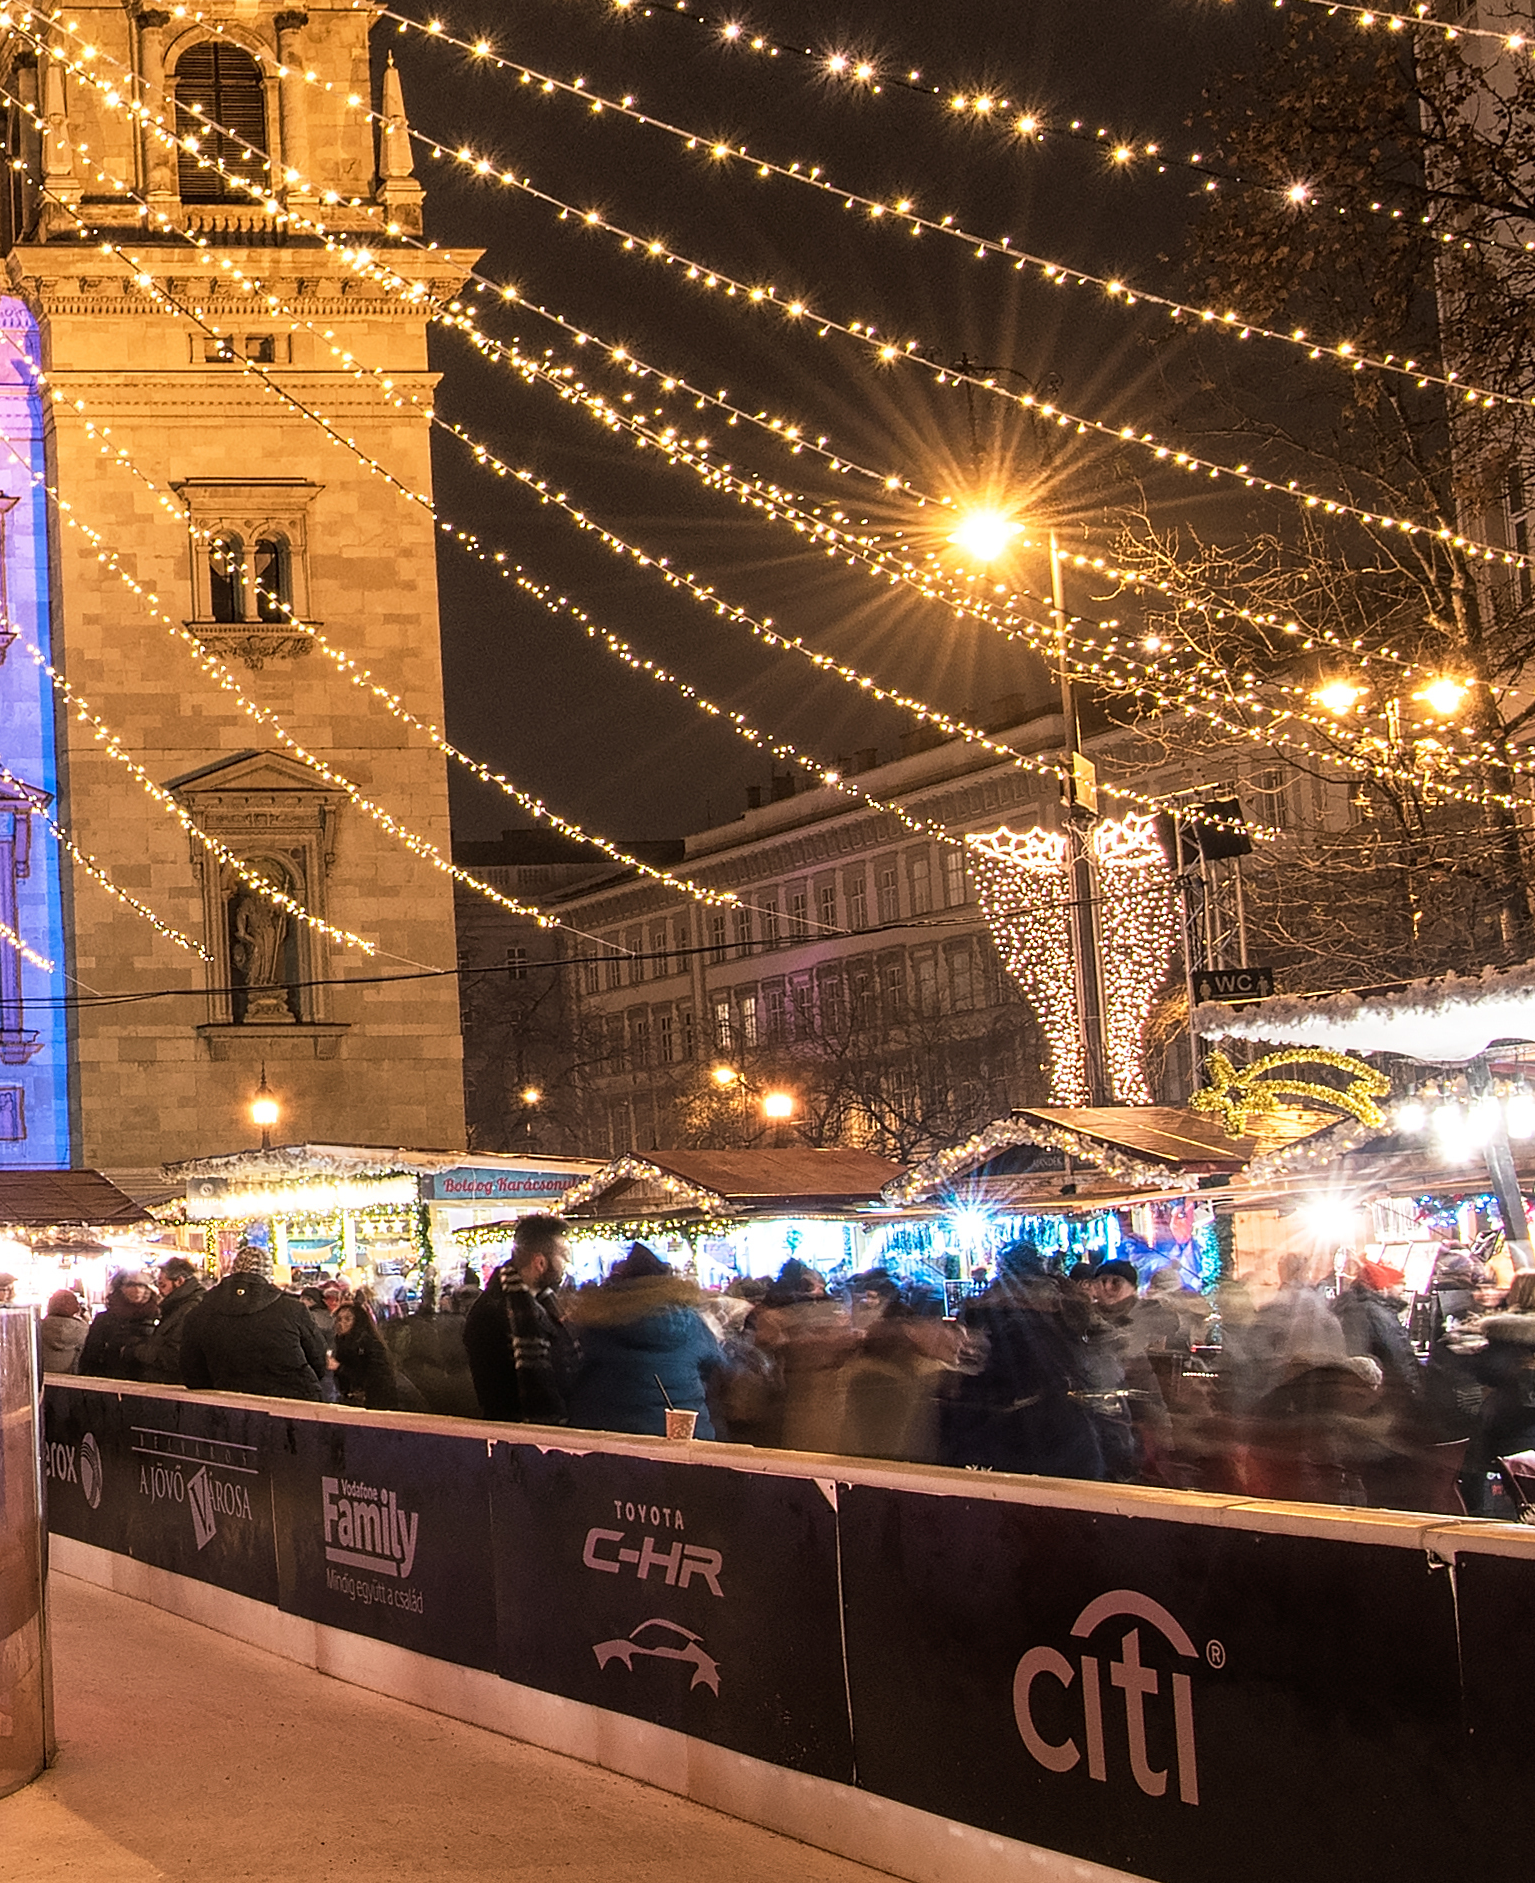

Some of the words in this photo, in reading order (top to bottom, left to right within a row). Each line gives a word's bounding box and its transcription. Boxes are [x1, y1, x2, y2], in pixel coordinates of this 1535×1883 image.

[1215, 974, 1252, 993] WC
[443, 1177, 493, 1195] Boldog
[139, 1465, 149, 1495] A
[150, 1462, 185, 1504] JÖVŐ
[341, 1478, 378, 1501] Vodafone
[322, 1476, 419, 1579] Family
[613, 1500, 685, 1530] TOYOTA
[583, 1527, 725, 1597] C-HR
[387, 1588, 394, 1606] a
[394, 1588, 424, 1614] család
[1013, 1589, 1200, 1806] citi
